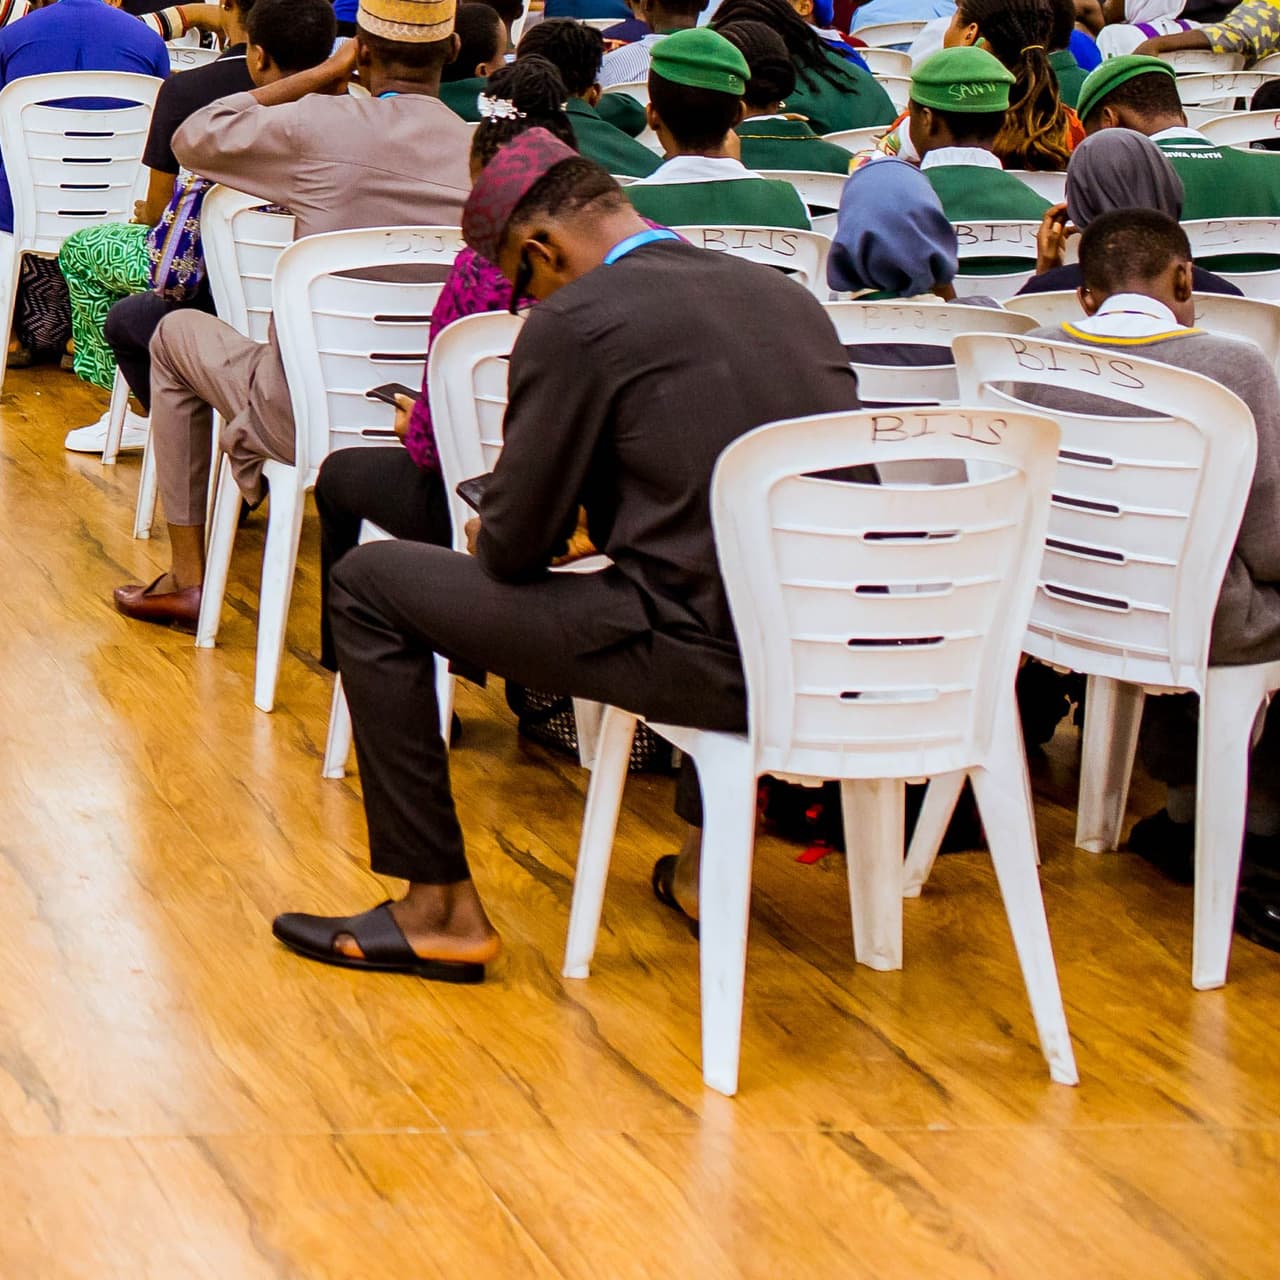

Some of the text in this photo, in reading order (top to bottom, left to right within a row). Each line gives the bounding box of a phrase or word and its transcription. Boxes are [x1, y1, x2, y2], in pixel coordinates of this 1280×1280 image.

[703, 229, 798, 257] BIJS
[1008, 338, 1145, 390] BIJS
[872, 413, 1008, 446] BIJS
